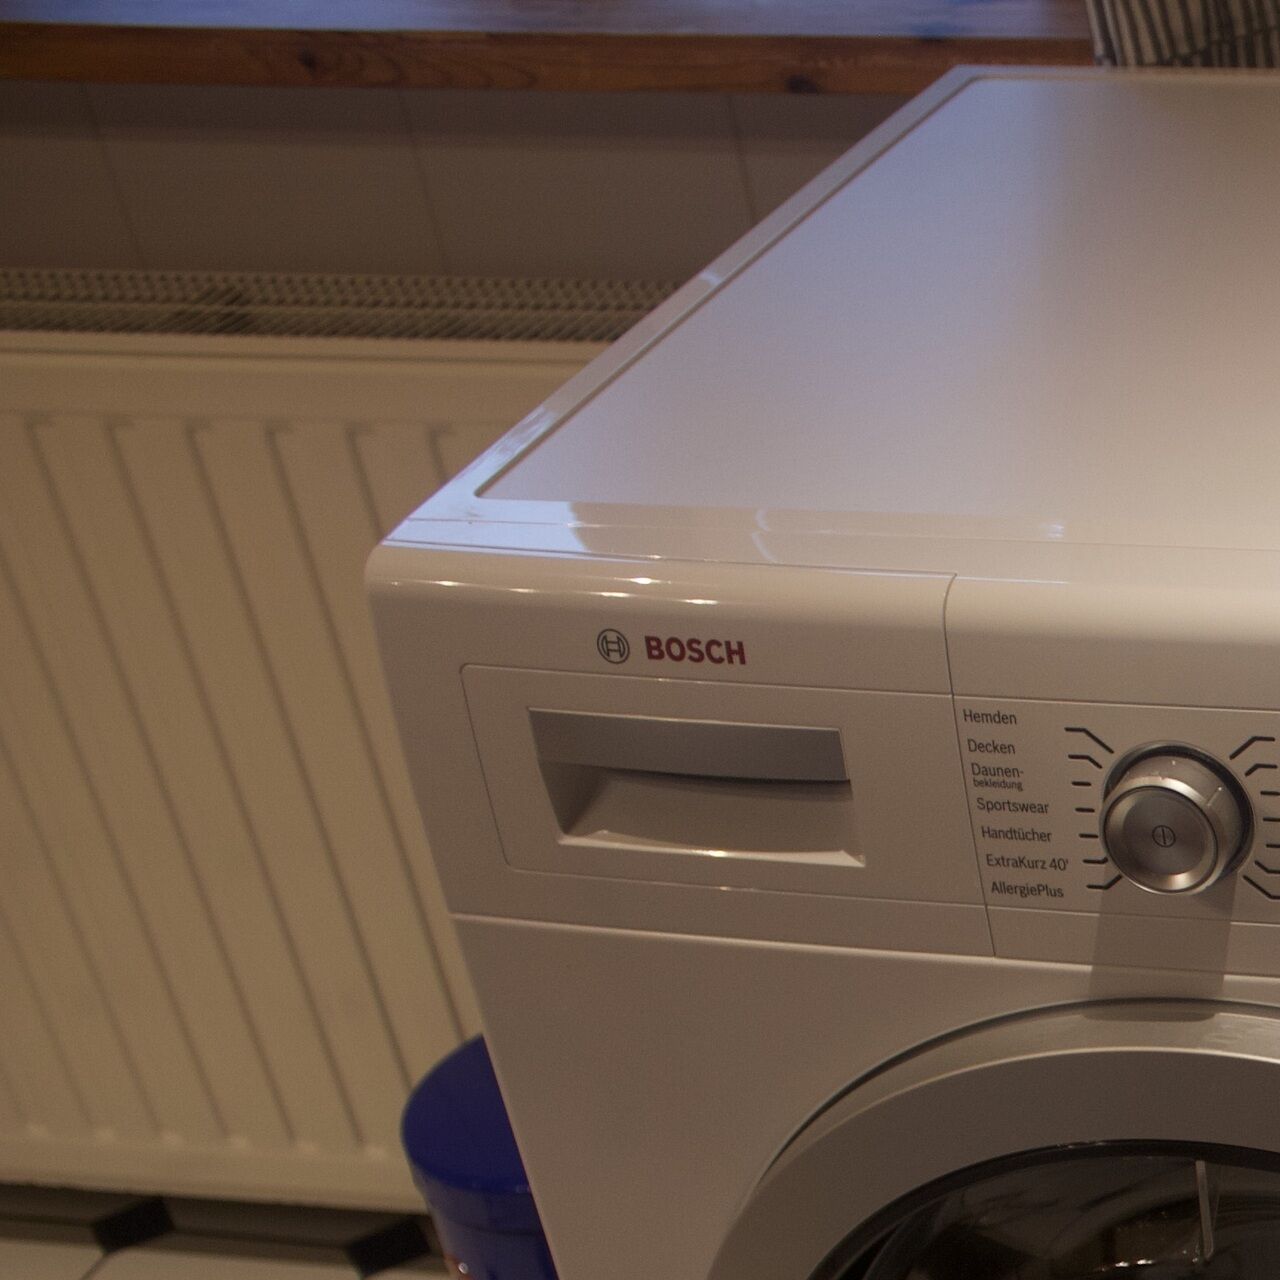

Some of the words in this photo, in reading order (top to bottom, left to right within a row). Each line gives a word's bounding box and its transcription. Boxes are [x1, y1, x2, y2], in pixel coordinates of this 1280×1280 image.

[645, 635, 746, 665] BOSCH
[963, 709, 1017, 725] Hemden
[967, 738, 1016, 755] Decken
[971, 763, 1023, 779] Daunen-
[973, 778, 1023, 792] bekleidung
[977, 797, 1049, 814] Sportswear
[981, 826, 1052, 842] Handtücher
[986, 854, 1046, 869] ExtraKurz
[991, 881, 1064, 898] AllergiePlus
